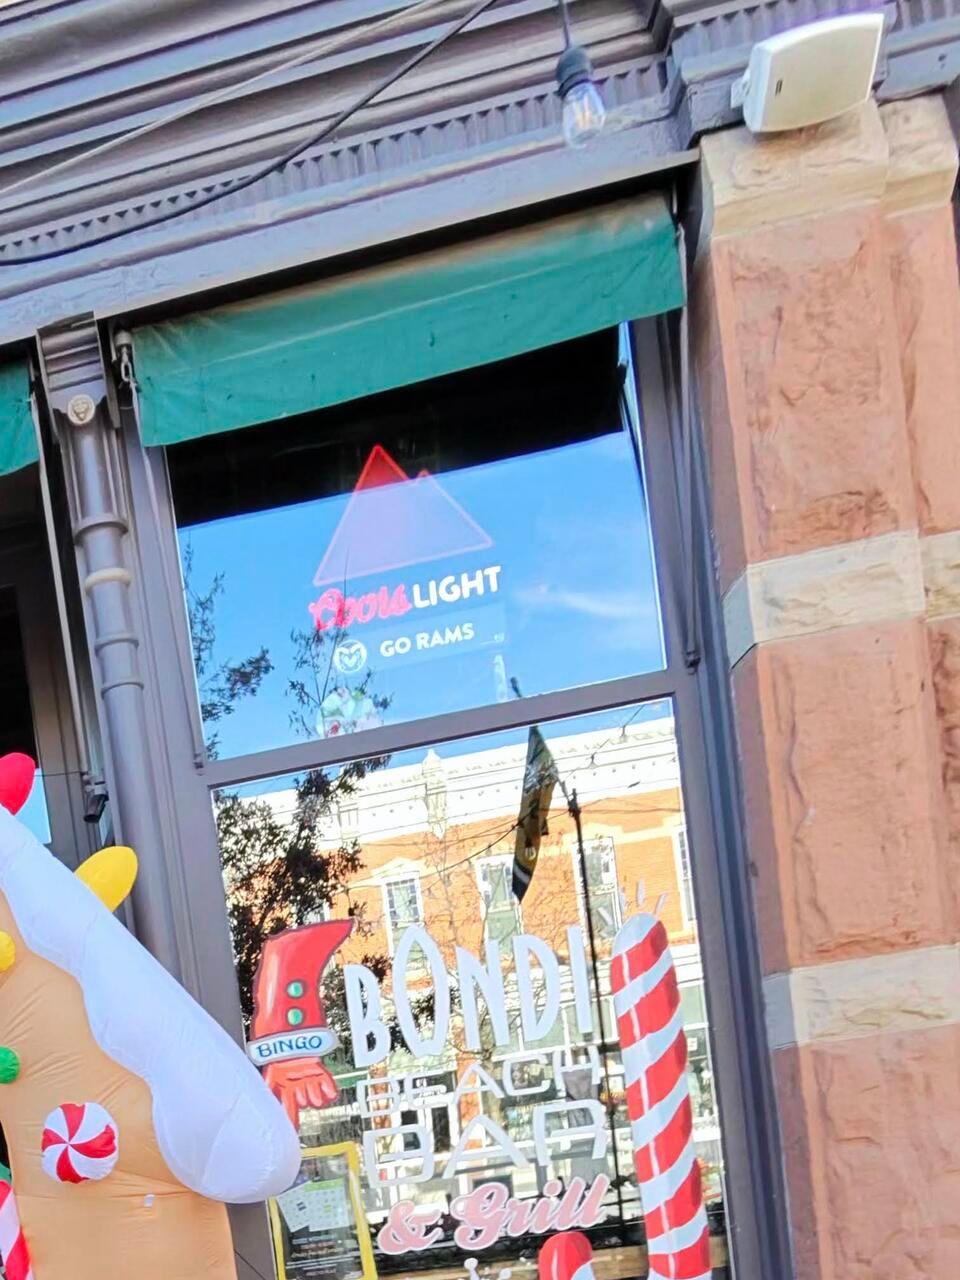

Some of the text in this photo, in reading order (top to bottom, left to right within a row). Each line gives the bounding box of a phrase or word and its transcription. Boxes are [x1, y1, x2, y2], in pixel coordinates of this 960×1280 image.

[308, 565, 502, 631] Coors LIGHT
[379, 622, 474, 658] GO RAMS
[343, 922, 593, 1068] BONDI
[255, 1034, 323, 1058] BINGO
[356, 1045, 602, 1119] BEACH
[362, 1098, 611, 1189] BAR
[377, 1200, 442, 1256] &
[451, 1172, 611, 1251] Grill
